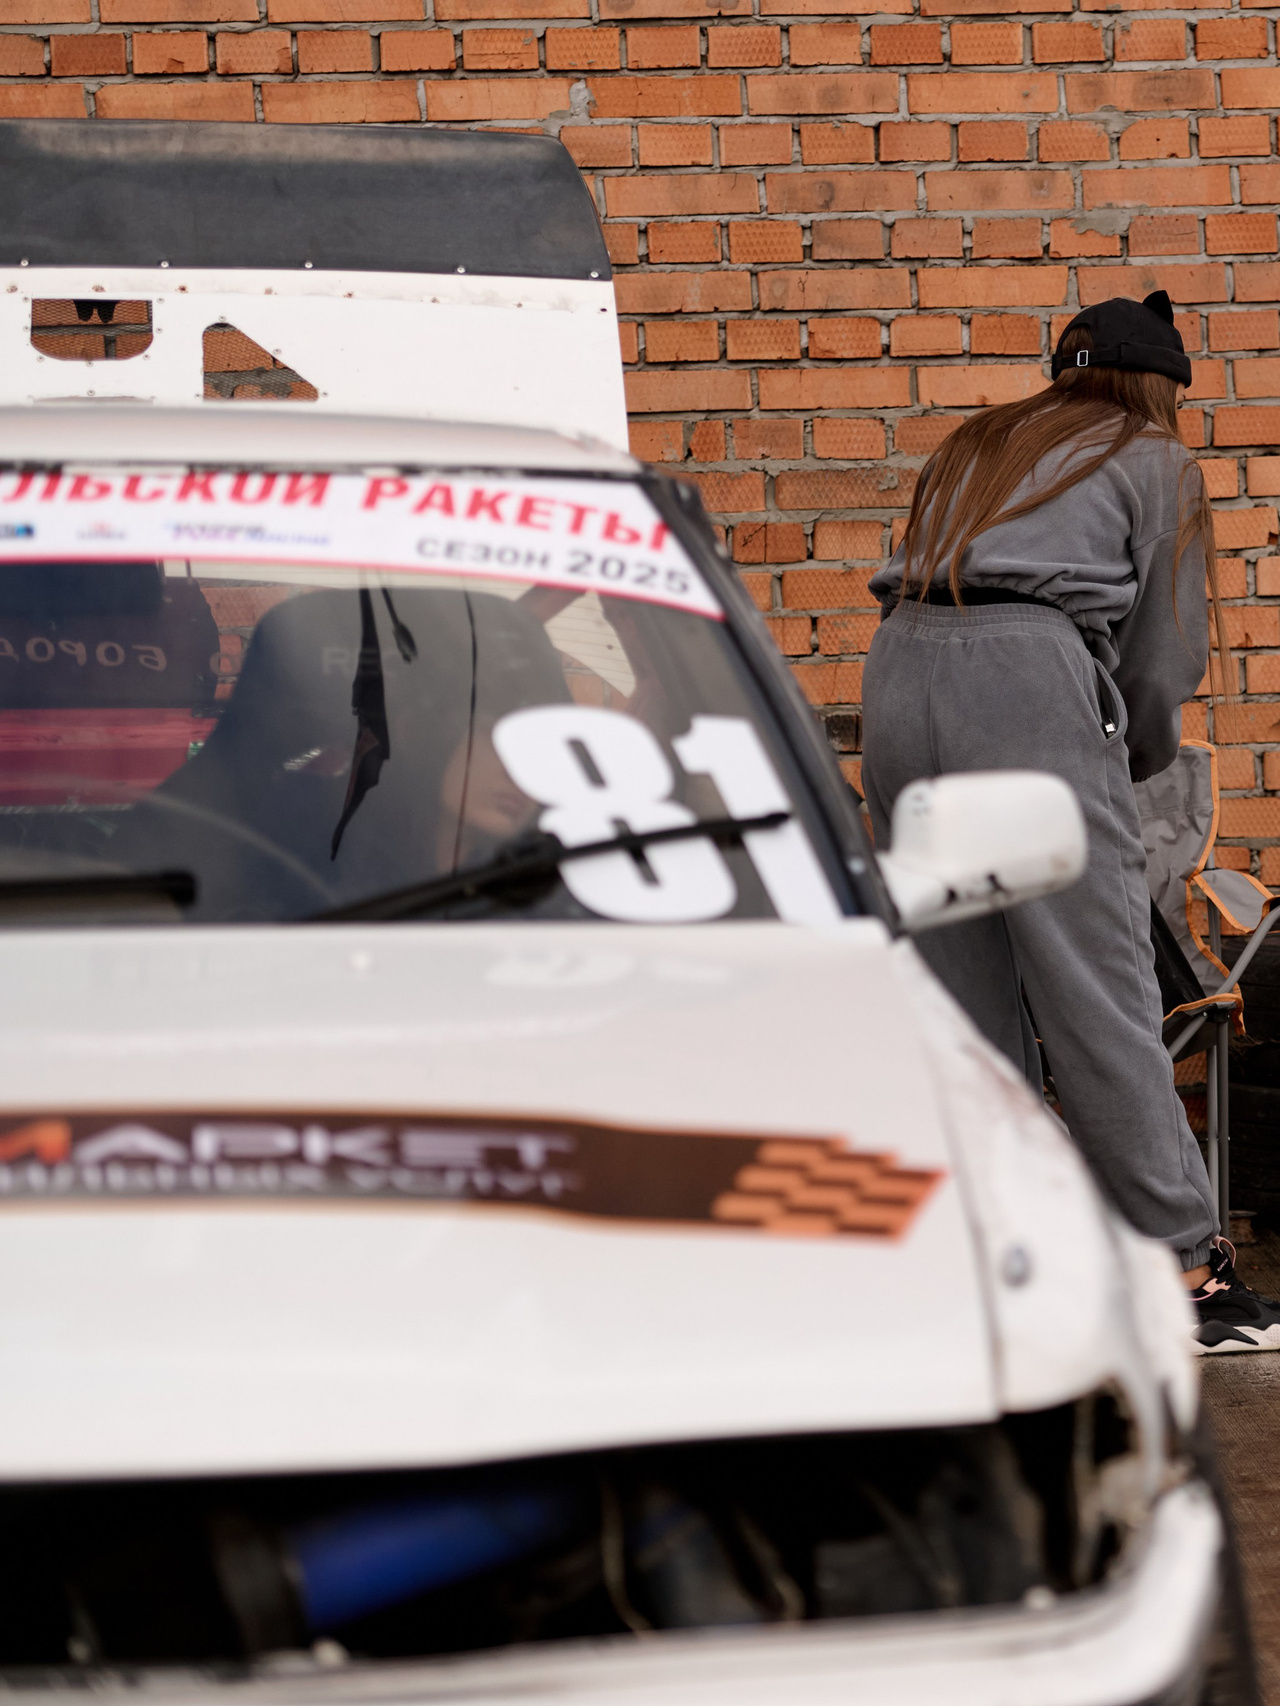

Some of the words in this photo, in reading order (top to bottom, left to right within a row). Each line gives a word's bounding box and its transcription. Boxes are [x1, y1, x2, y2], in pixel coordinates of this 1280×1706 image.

[361, 476, 672, 552] РАКЕТЫ
[415, 537, 551, 569] СЕЗОН
[566, 550, 691, 596] 2025
[492, 704, 845, 926] 81
